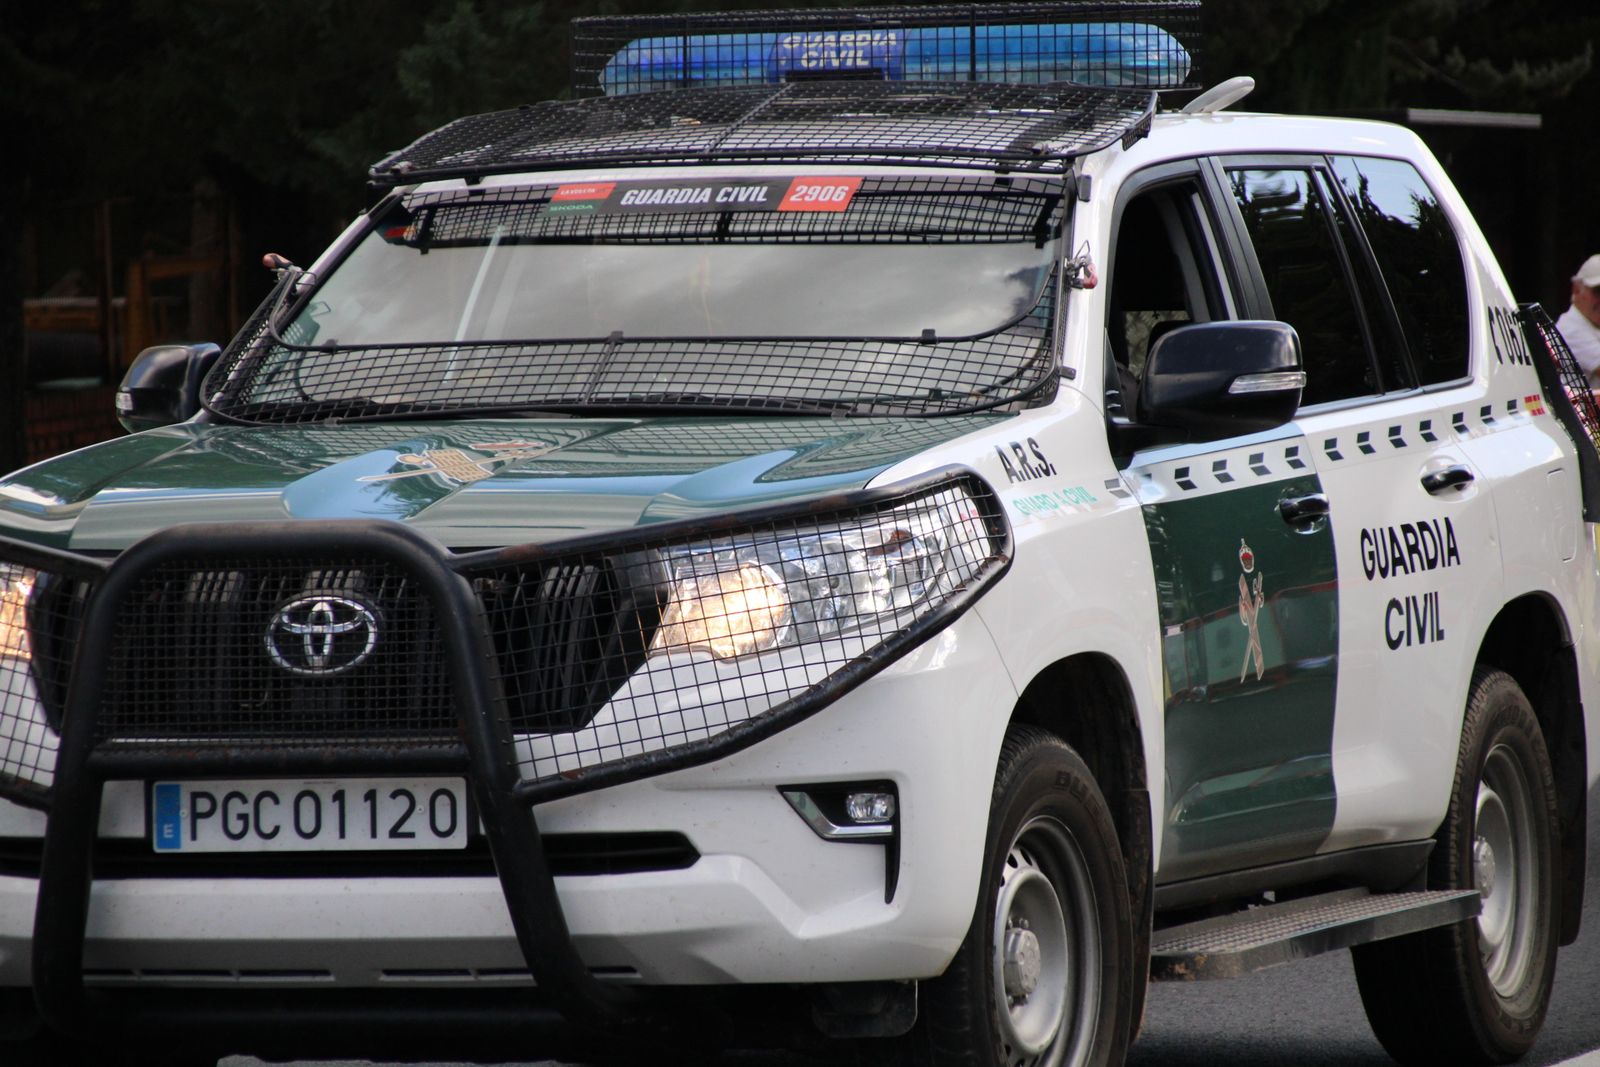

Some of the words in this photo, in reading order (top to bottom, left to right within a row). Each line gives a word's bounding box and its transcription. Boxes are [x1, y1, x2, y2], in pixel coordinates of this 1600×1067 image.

[782, 32, 898, 49] GUARDIA
[800, 50, 870, 68] CIVIL
[620, 188, 712, 206] GUARDIA
[715, 186, 768, 203] CIVIL
[790, 185, 850, 202] 2906
[994, 437, 1057, 484] A.R.S.
[1013, 491, 1073, 516] GUARDA
[1360, 517, 1461, 581] GUARDIA
[1385, 591, 1445, 651] CIVIL
